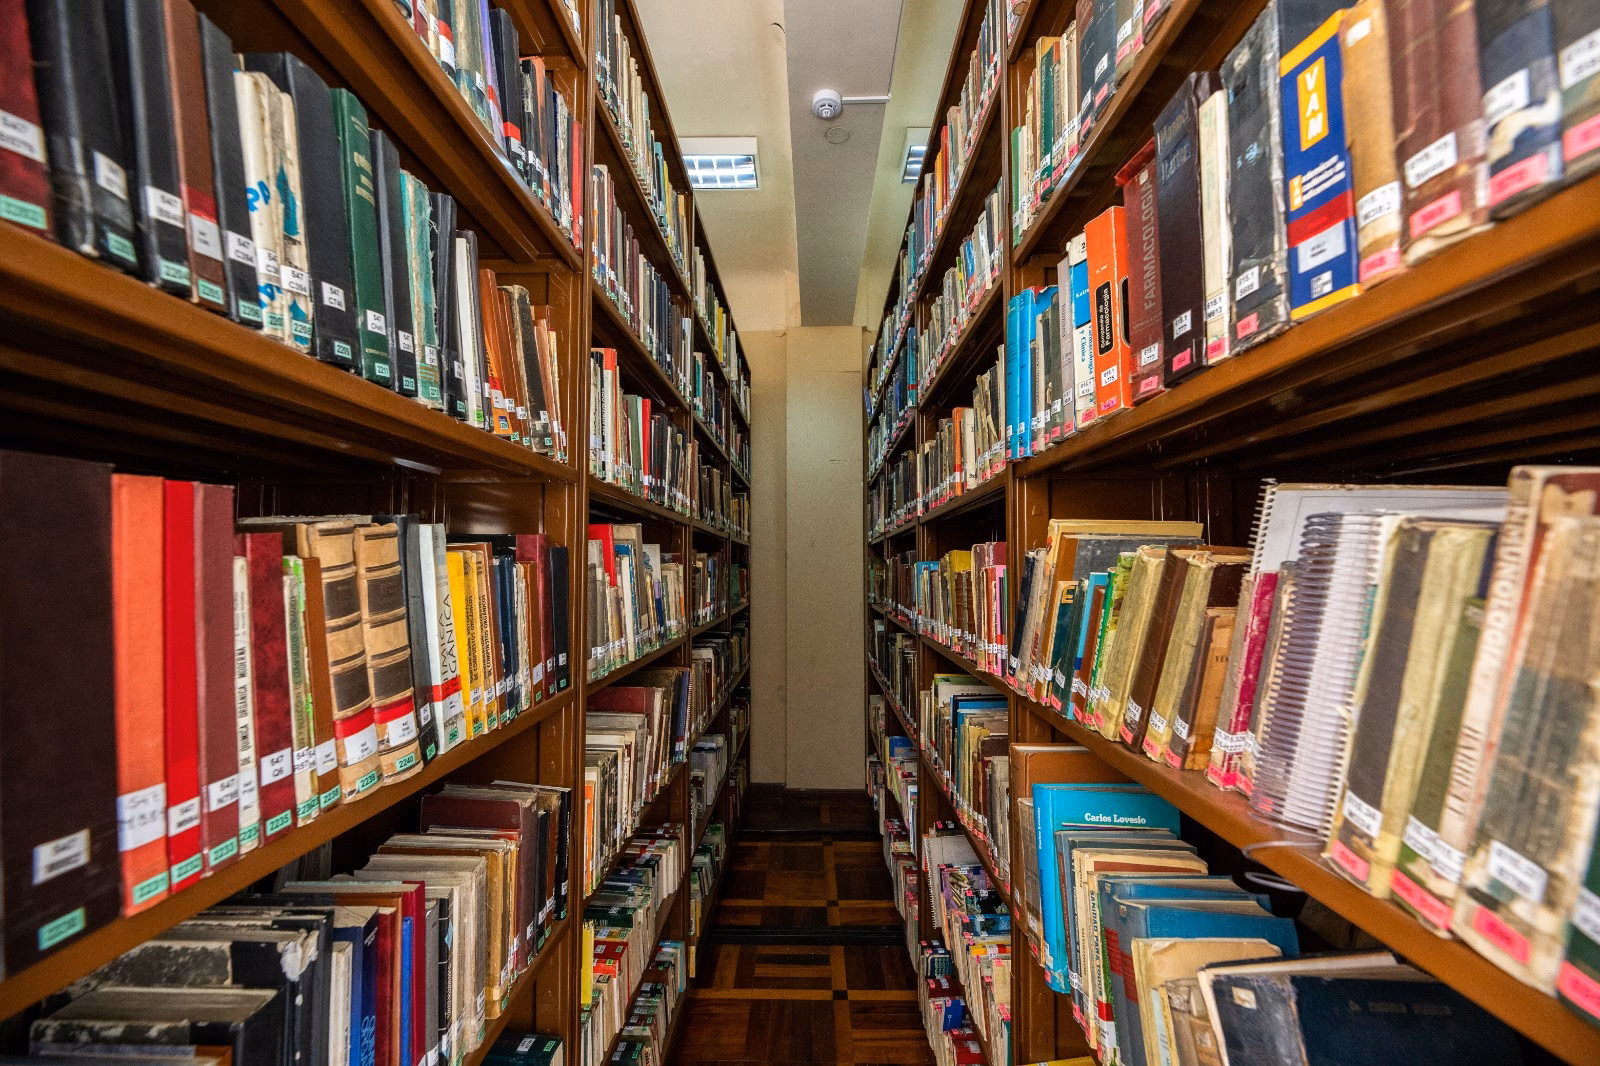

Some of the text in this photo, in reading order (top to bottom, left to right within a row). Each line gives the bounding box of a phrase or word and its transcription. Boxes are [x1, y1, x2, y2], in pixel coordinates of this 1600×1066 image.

[1304, 65, 1324, 142] VAM
[291, 269, 305, 281] 547
[329, 286, 340, 297] 547
[1206, 296, 1222, 309] 615.1
[1061, 585, 1075, 604] E
[270, 754, 284, 767] 547
[398, 755, 414, 769] 2240
[1084, 812, 1147, 825] Carlos Lovesio
[1089, 889, 1098, 932] SANIDAD
